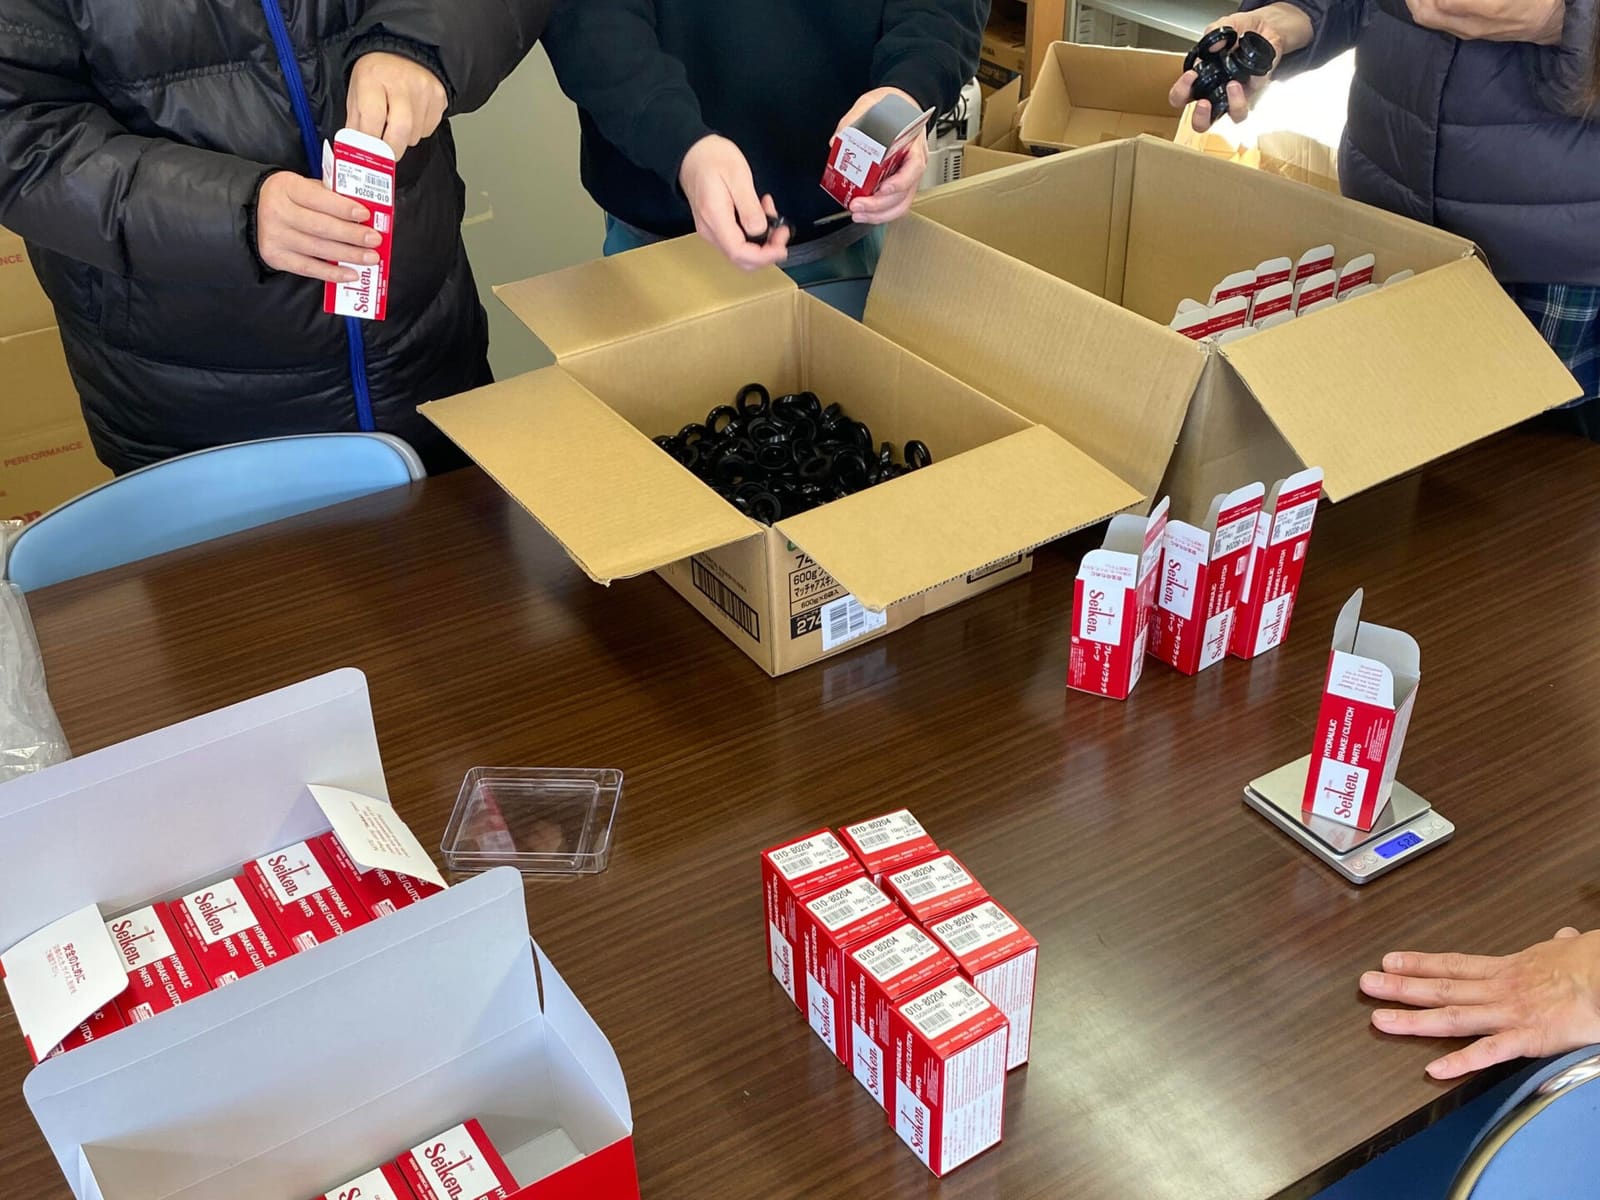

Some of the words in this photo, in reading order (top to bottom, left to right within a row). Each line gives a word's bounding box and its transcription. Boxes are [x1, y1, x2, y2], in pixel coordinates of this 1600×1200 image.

[343, 268, 372, 313] Seiken
[4, 441, 83, 467] PERFORMANCE
[1165, 559, 1188, 604] Seiken
[1086, 589, 1115, 635] Seiken
[1323, 719, 1338, 757] HYDRAULIC
[1337, 706, 1355, 761] BRAKE/CLUTCH
[1350, 743, 1362, 765] PARTS
[1323, 771, 1359, 818] Seiken
[267, 854, 310, 897] Seiken
[194, 892, 237, 936] Seiken
[297, 897, 315, 918] PARTS
[327, 886, 352, 918] HYDRAULIC
[112, 919, 155, 966] Seiken
[222, 937, 239, 958] PARTS
[237, 931, 265, 970] BRAKE/CLUT
[253, 924, 278, 958] HYDRAULIC
[858, 936, 899, 961] 010-80204
[138, 966, 154, 988] PARTS
[153, 960, 182, 1007] BRAKE/CLUTC
[169, 953, 193, 989] HYDRAULIC
[904, 990, 947, 1016] 010-80204
[901, 1106, 924, 1154] Seiken
[424, 1142, 473, 1200] Seiken
